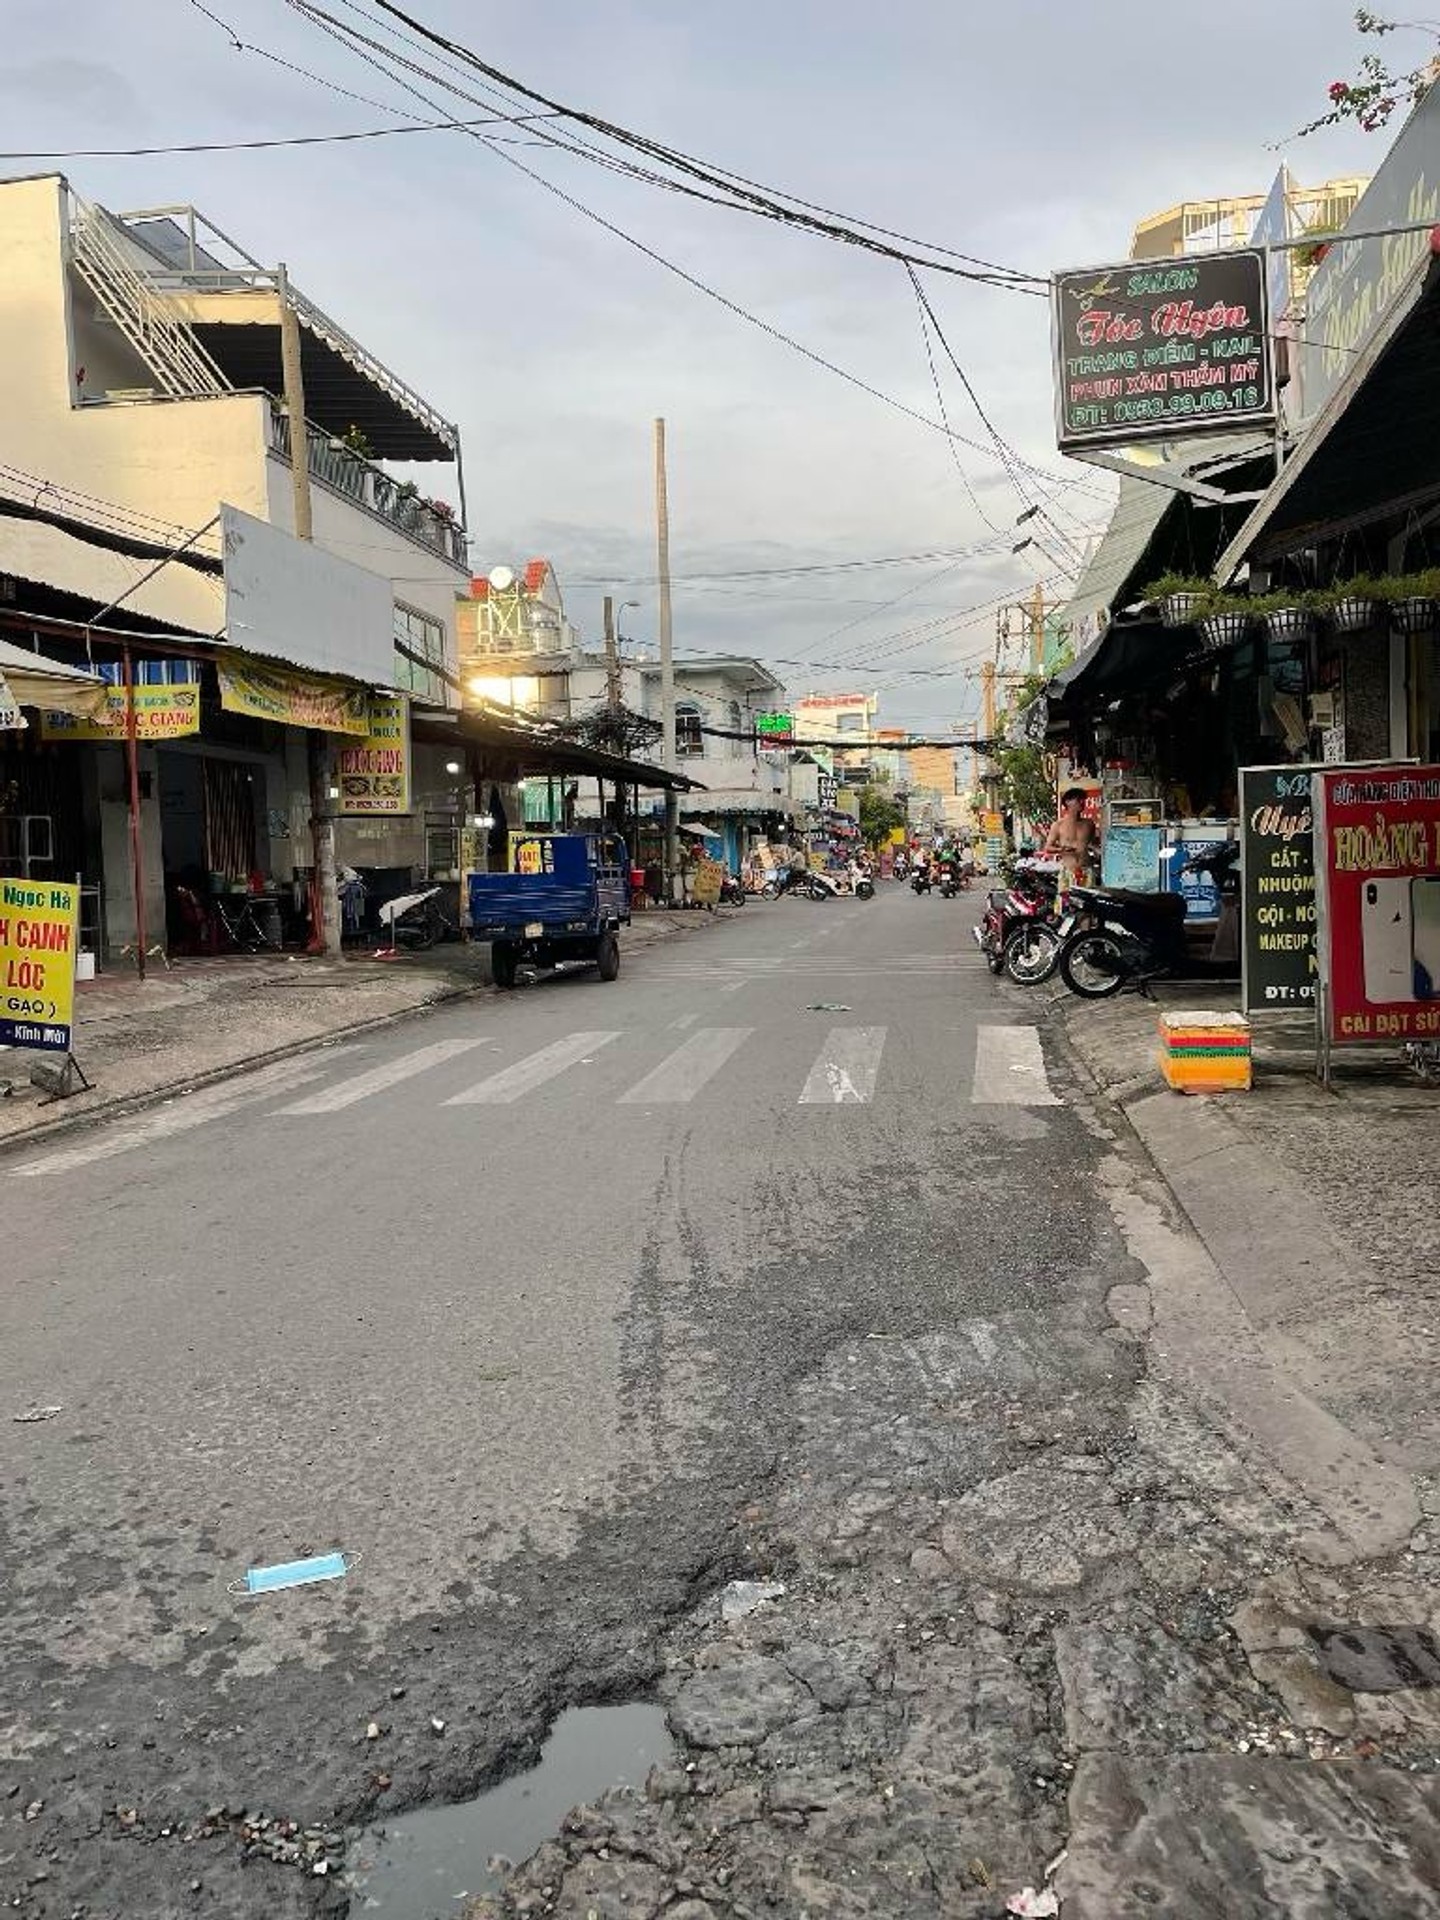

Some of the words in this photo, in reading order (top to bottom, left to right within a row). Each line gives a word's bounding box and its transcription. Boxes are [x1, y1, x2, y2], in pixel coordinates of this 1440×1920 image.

[1127, 267, 1198, 297] SALON
[1066, 350, 1137, 376] TRANG
[1213, 336, 1261, 358] NAIL
[1070, 378, 1123, 402] PHUN
[4, 886, 45, 910] Ngọc
[51, 891, 71, 910] Hà
[17, 920, 70, 952] CANH
[1259, 934, 1309, 950] MAKEUP
[7, 957, 46, 991] LÓC
[1265, 986, 1295, 999] ĐT:
[7, 997, 45, 1016] GẠO
